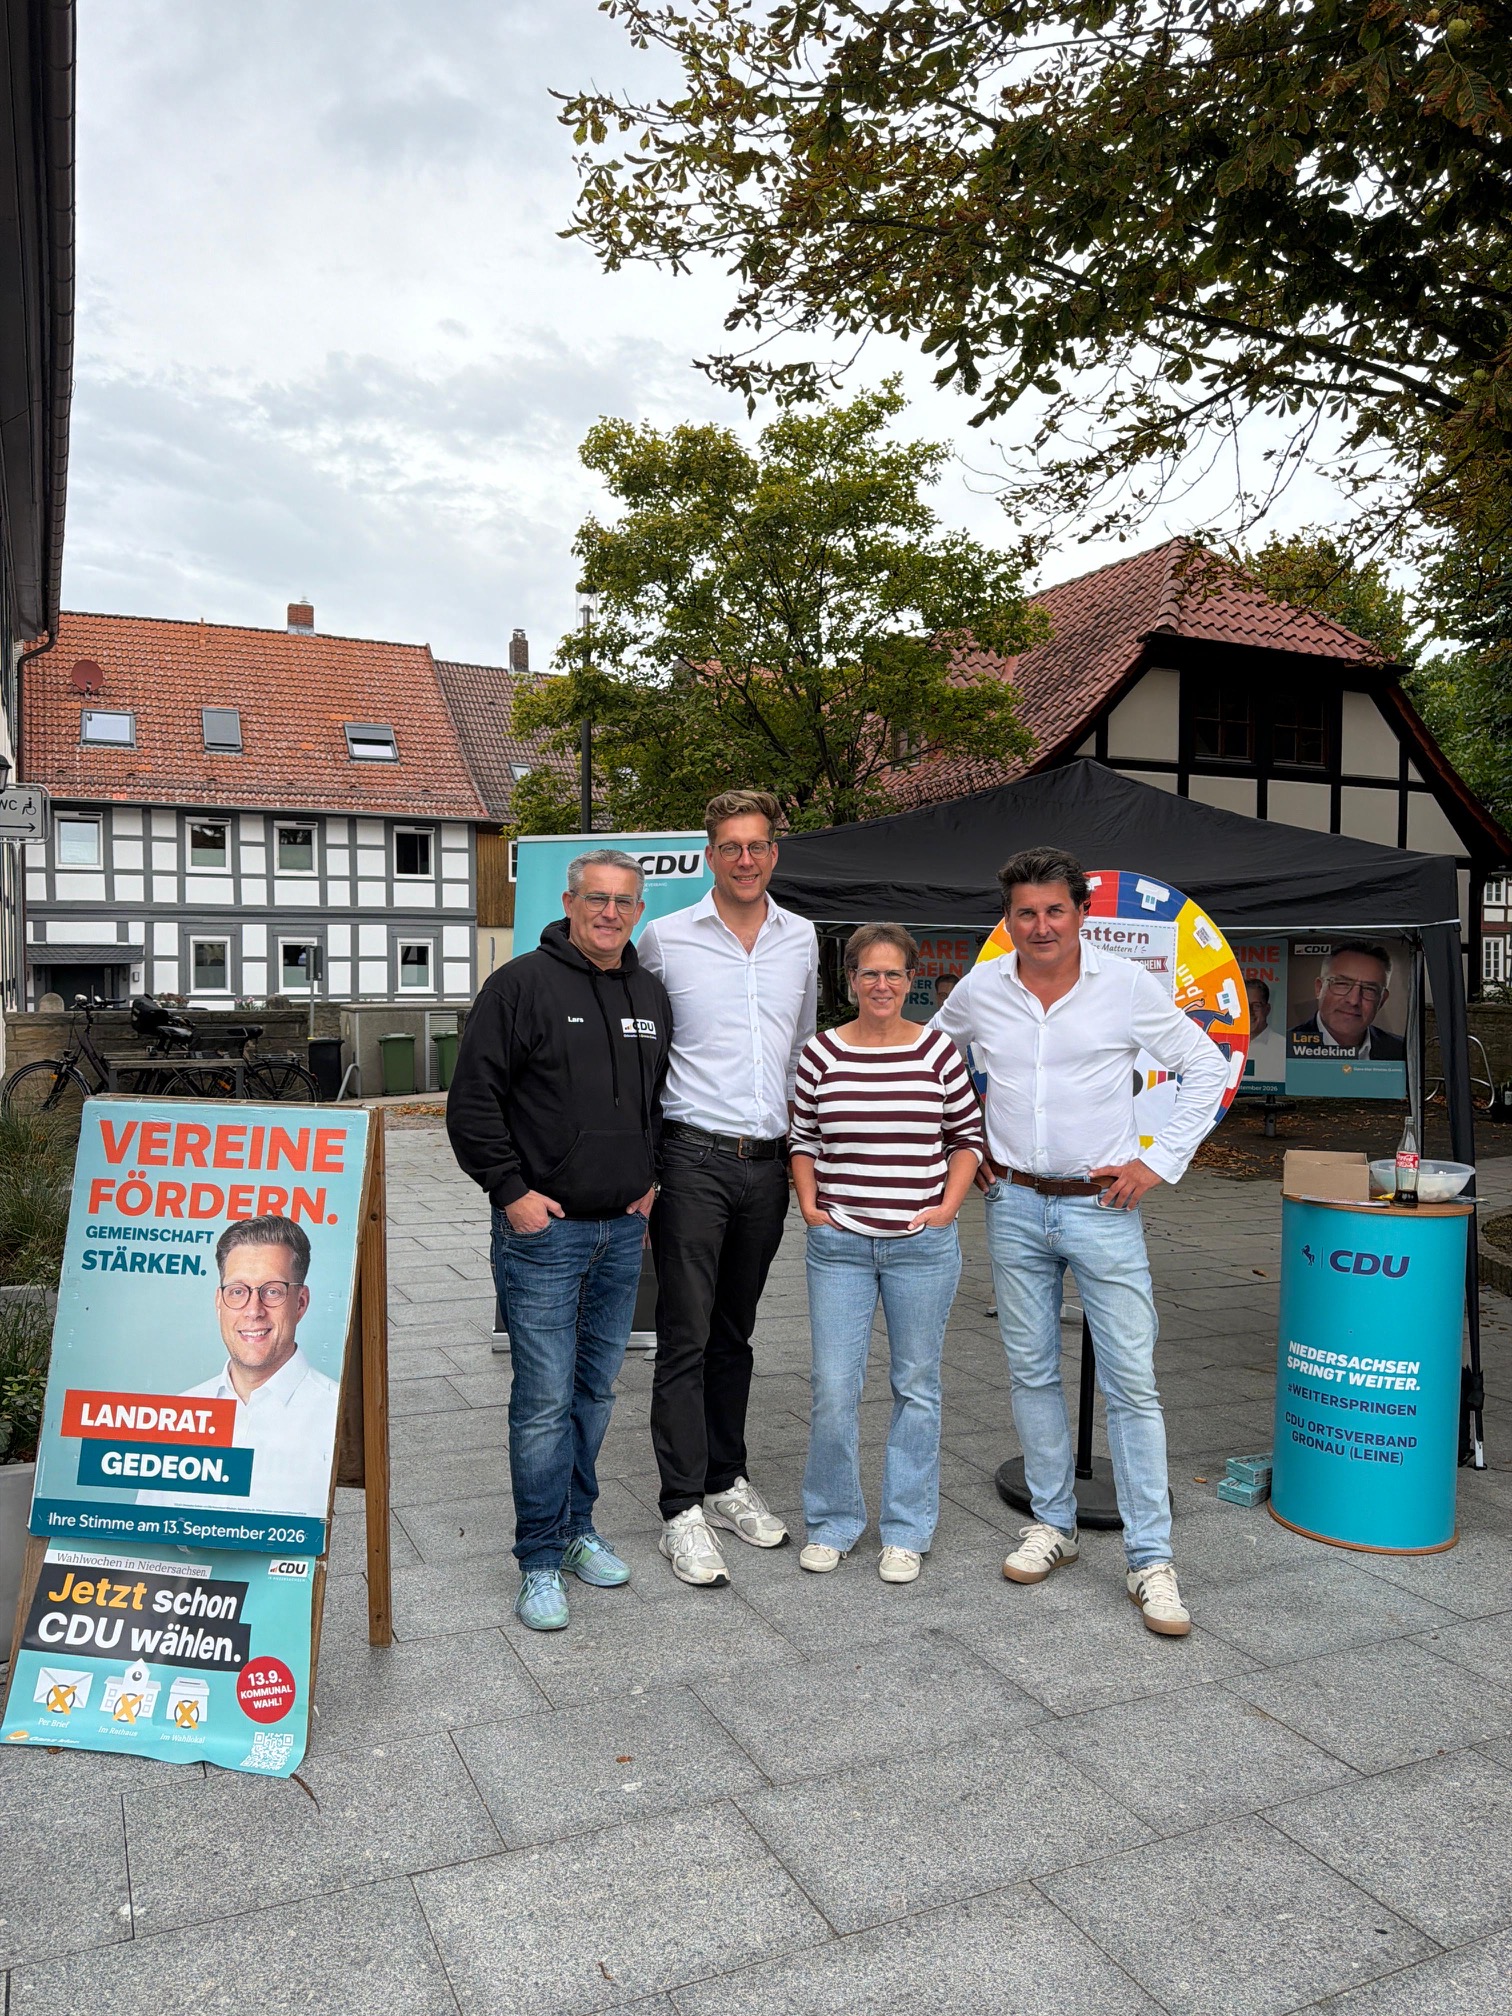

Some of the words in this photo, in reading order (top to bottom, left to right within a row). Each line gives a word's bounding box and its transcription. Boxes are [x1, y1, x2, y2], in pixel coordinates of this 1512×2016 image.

[638, 854, 700, 875] CDU
[1080, 926, 1149, 945] attern
[918, 938, 969, 960] ARE
[1101, 943, 1133, 953] Mattern
[1304, 945, 1330, 953] CDU
[914, 962, 963, 978] GELN
[1241, 967, 1280, 982] RN.
[1177, 963, 1203, 998] und
[906, 992, 934, 1005] RS.
[567, 1015, 584, 1023] Lars
[632, 1021, 654, 1031] CDU
[1293, 1032, 1320, 1043] Lars
[1293, 1045, 1356, 1057] Wedekind
[99, 1119, 348, 1173] VEREINE
[88, 1169, 339, 1225] FÖRDERN.
[85, 1225, 214, 1244] GEMEINSCHAFT
[81, 1245, 207, 1276] STÄRKEN.
[1329, 1249, 1410, 1278] CDU
[1289, 1340, 1420, 1375] NIEDERSACHSEN
[1287, 1355, 1346, 1383] SPRINGT
[1349, 1372, 1421, 1391] WEITER.
[1287, 1382, 1417, 1416] #WEITERSPRINGEN
[80, 1403, 216, 1434] LANDRAT.
[1285, 1411, 1305, 1429] CDU
[1307, 1421, 1417, 1448] ORTSVERBAND
[1292, 1430, 1345, 1456] GRONAU
[1349, 1446, 1404, 1466] (LEINE)
[101, 1451, 230, 1483] GEDEON.
[48, 1512, 76, 1527] Ihre
[79, 1513, 135, 1531] Stimme
[137, 1520, 159, 1532] am
[162, 1520, 180, 1534] 13.
[182, 1521, 265, 1540] September
[267, 1527, 305, 1543] 2026
[57, 1552, 123, 1568] Wahlwochen
[125, 1558, 135, 1569] in
[137, 1561, 208, 1578] Niedersachsen.
[278, 1562, 306, 1574] CDU
[48, 1573, 147, 1610] Jetzt
[152, 1587, 237, 1620] schon
[38, 1612, 124, 1649] CDU
[131, 1623, 241, 1662] wählen.
[247, 1670, 282, 1686] 13.9.
[240, 1684, 293, 1699] KOMMUNAL
[253, 1697, 283, 1709] WAHL!
[38, 1717, 49, 1726] Per
[51, 1719, 70, 1729] Brief
[109, 1727, 138, 1737] Rathaus
[171, 1734, 205, 1744] Wahllokal
